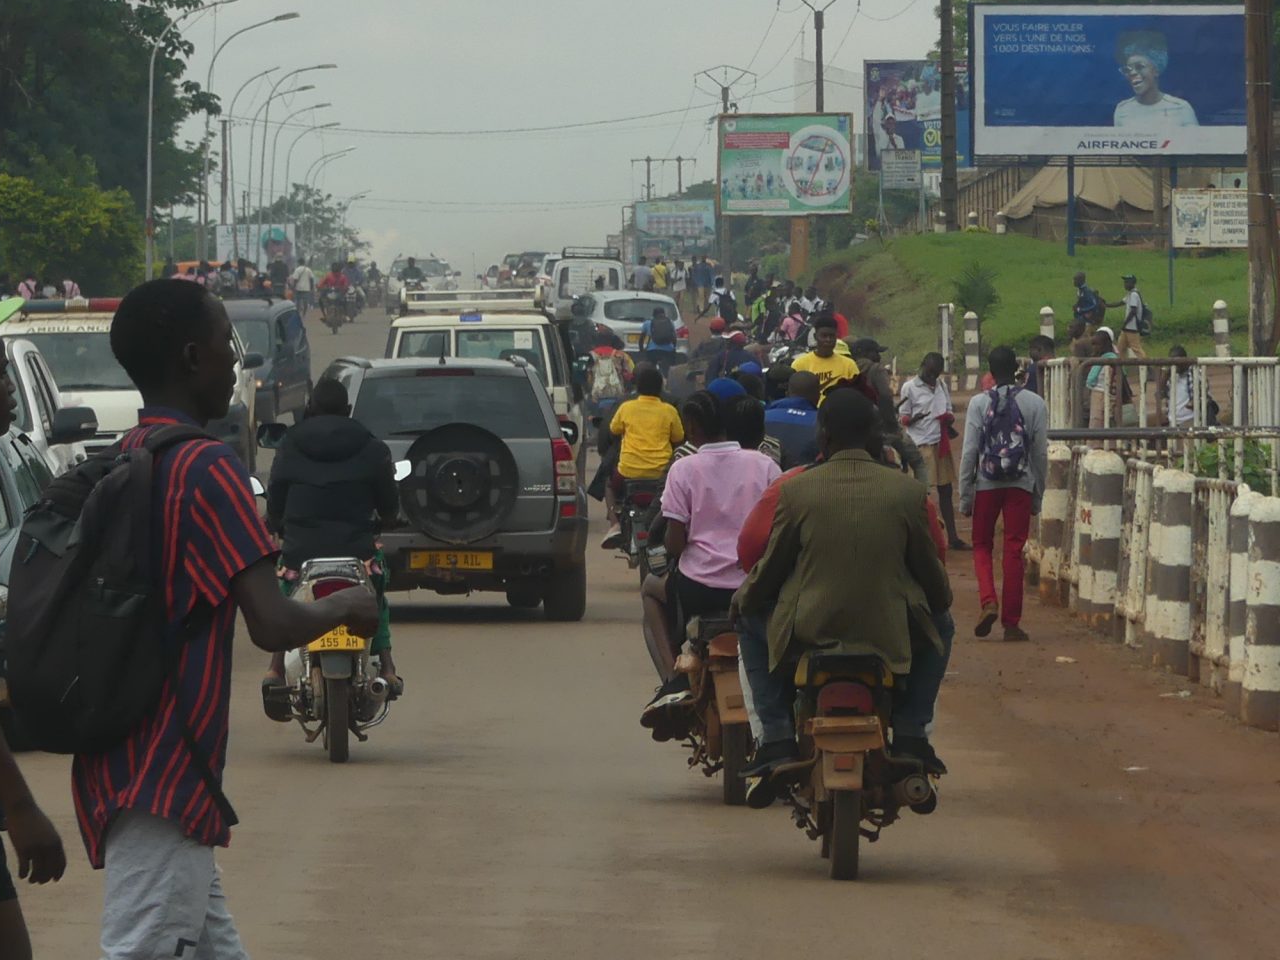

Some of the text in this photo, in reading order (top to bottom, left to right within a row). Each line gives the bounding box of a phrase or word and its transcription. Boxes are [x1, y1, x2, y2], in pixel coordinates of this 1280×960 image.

[992, 23, 1084, 32] VOUS FAIRE VOLER
[992, 33, 1087, 42] VERS L'UNE DE NOS
[992, 44, 1019, 53] 1000
[1077, 140, 1157, 149] AIRFRANCE
[320, 637, 359, 648] 155 AH
